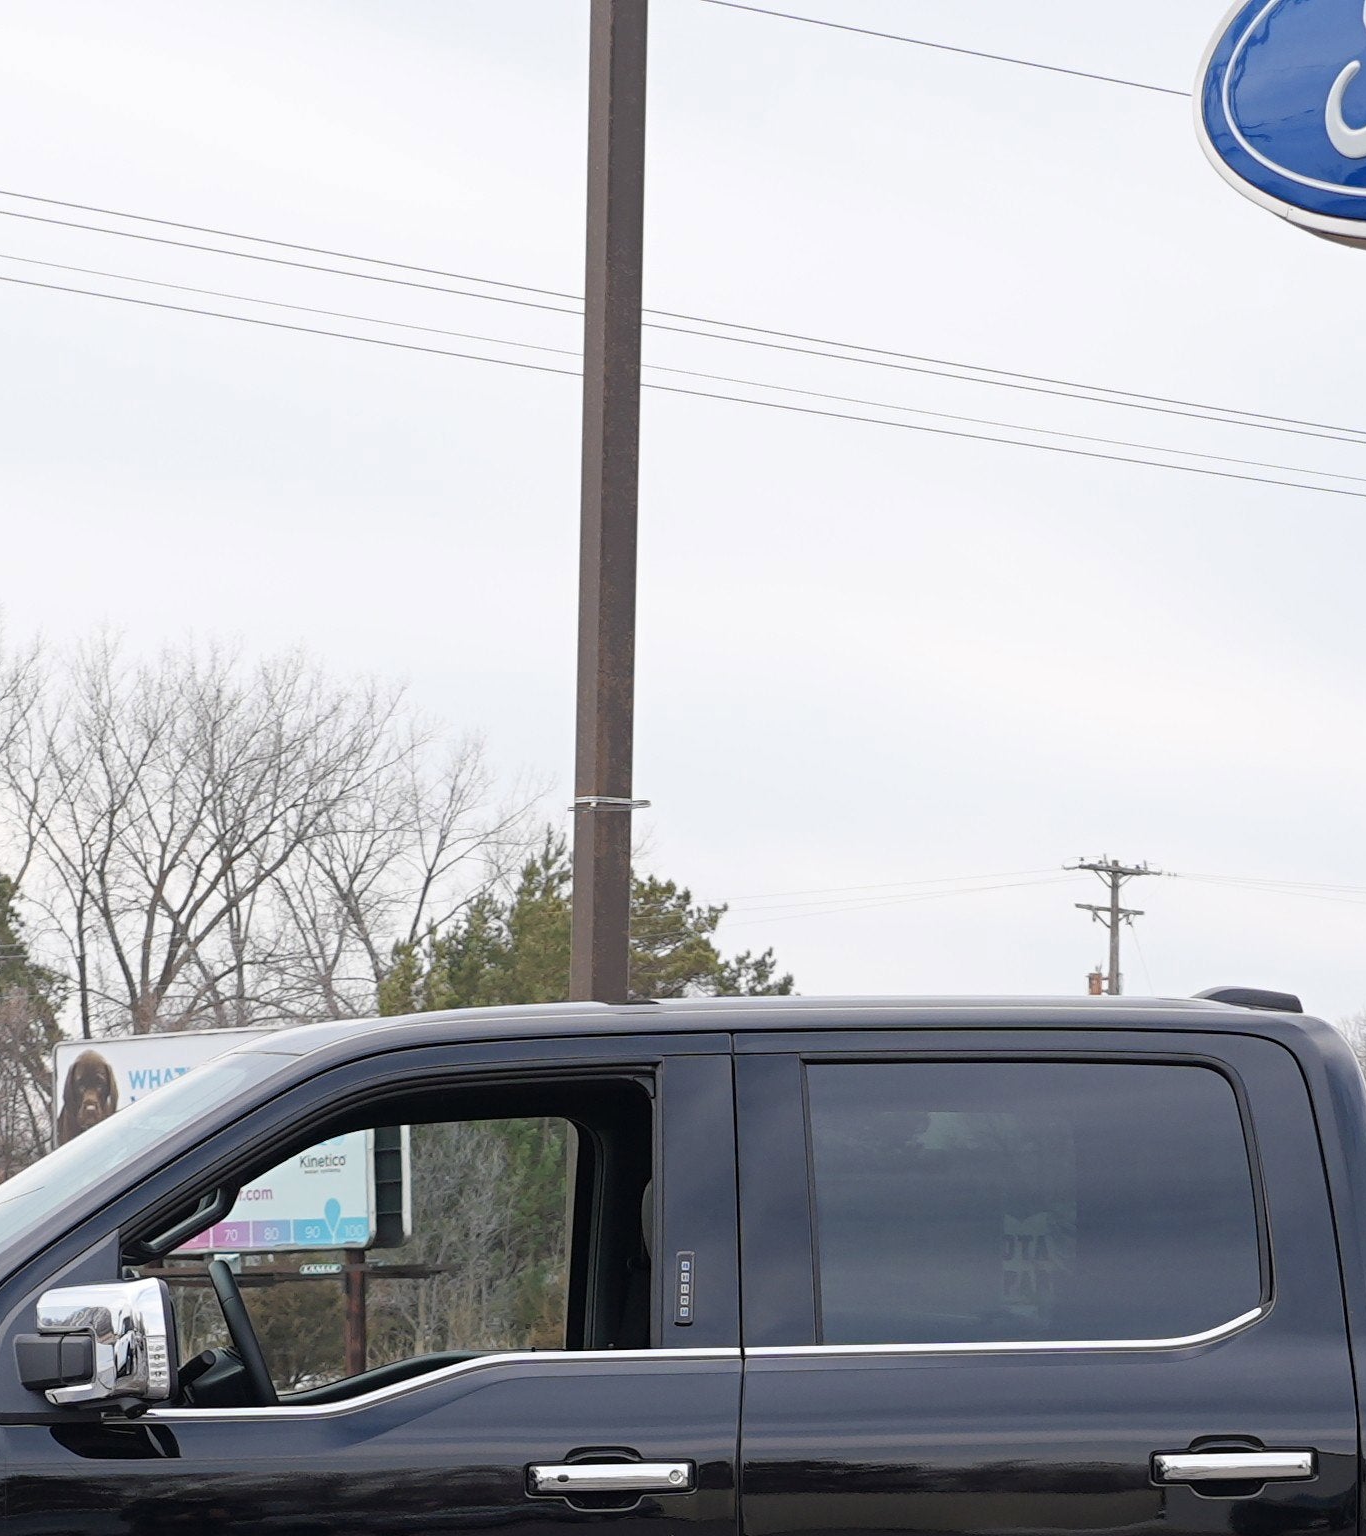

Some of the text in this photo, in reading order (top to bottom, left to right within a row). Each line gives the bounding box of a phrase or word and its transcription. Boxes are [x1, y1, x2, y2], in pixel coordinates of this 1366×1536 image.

[300, 1154, 346, 1168] Kinetico
[224, 1225, 364, 1242] 70 80 90 100
